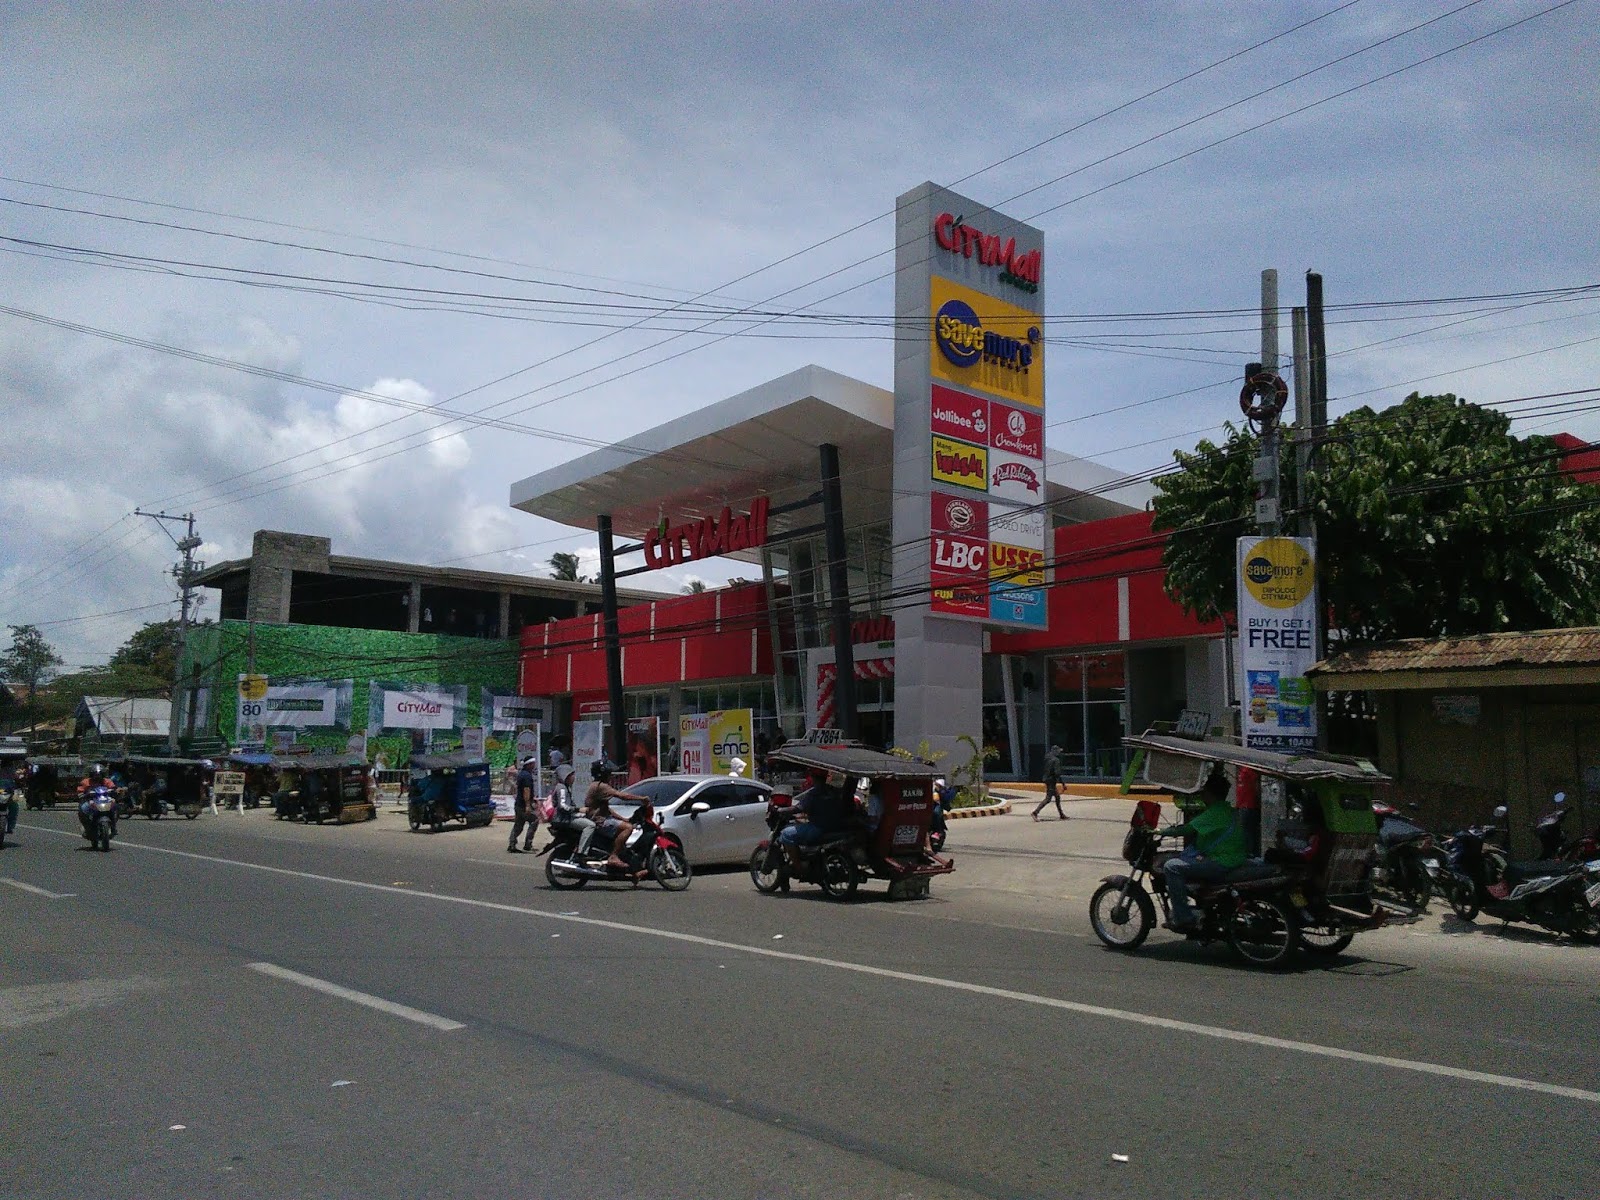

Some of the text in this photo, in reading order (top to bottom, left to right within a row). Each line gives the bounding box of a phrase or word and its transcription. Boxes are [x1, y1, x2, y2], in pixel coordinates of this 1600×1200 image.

[933, 407, 972, 428] Jollibee
[935, 538, 984, 571] LBC
[934, 589, 954, 600] FUN
[1249, 618, 1312, 628] BUY 1 GET 1
[1249, 629, 1311, 649] FREE
[242, 704, 261, 716] 80
[713, 742, 750, 755] emc
[692, 751, 701, 762] AM
